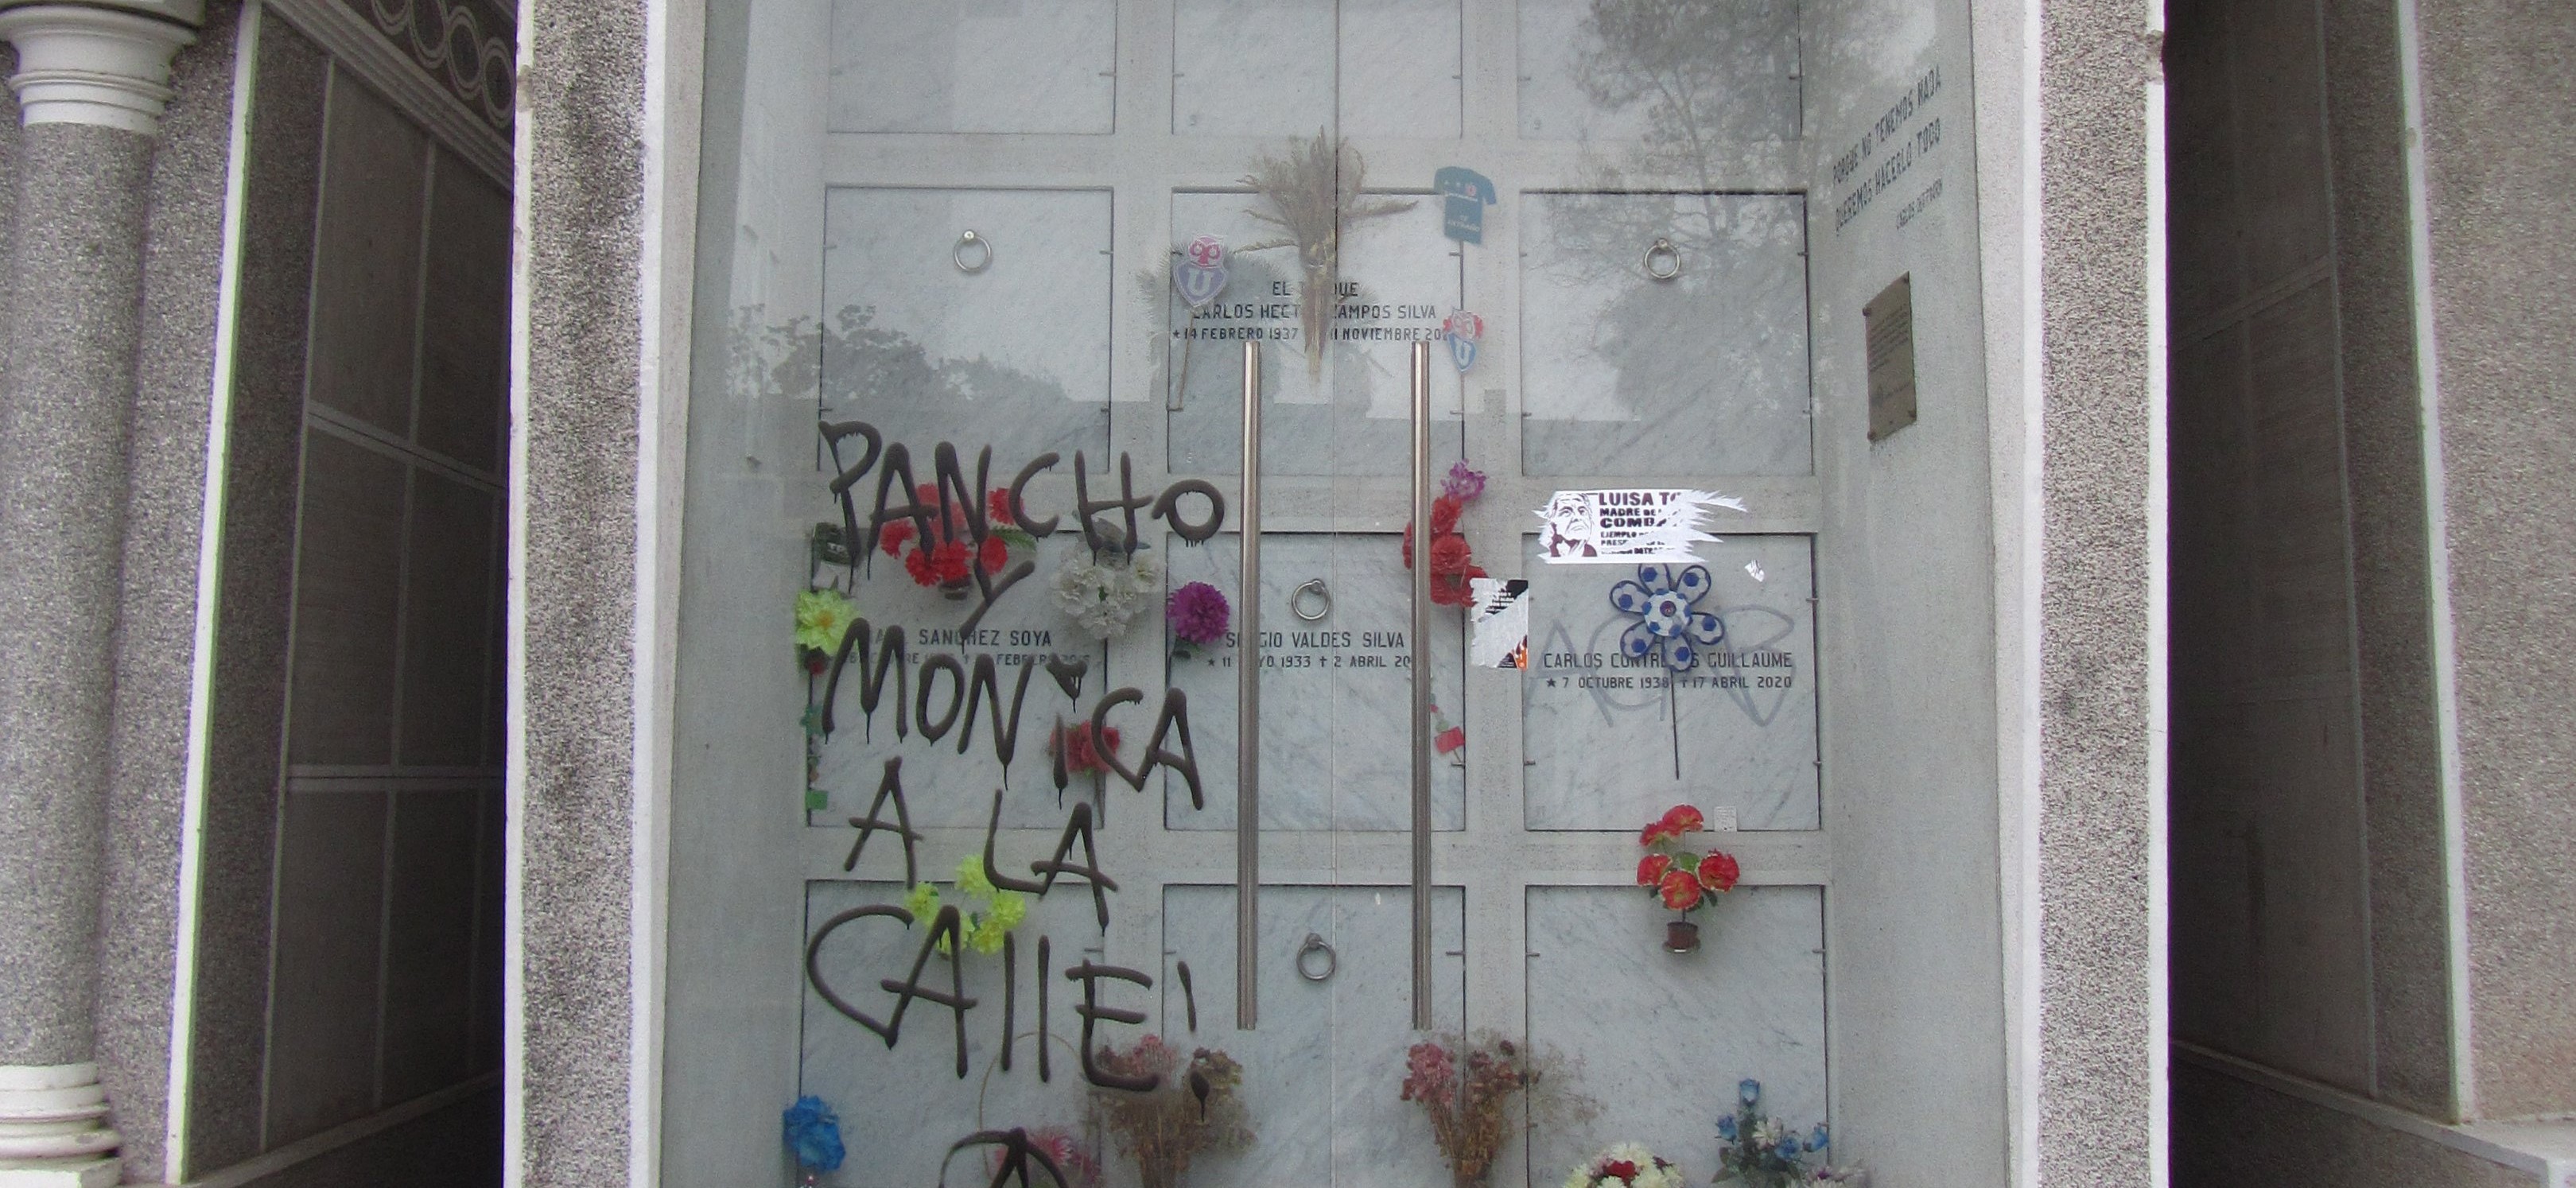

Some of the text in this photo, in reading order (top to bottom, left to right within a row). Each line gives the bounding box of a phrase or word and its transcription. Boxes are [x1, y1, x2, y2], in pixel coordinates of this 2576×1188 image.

[1875, 89, 1914, 145] TENEMOS
[1917, 64, 1941, 108] NADA
[1875, 142, 1913, 196] HACERLO
[1917, 118, 1941, 157] TODO
[1272, 281, 1291, 296] EL
[1261, 304, 1302, 319] HECT
[1397, 305, 1436, 319] SILVA
[1202, 327, 1263, 340] FEBRERO
[1269, 327, 1298, 340] 1937
[1342, 328, 1420, 341] NOVIEMBRE
[818, 420, 1225, 587] PANCHO
[1599, 491, 1654, 506] LUISA
[1599, 507, 1640, 517] MADRE
[960, 560, 1035, 643] Y
[1010, 630, 1052, 646] SOYA
[1292, 631, 1351, 648] VALDES
[1362, 631, 1405, 648] SILVA
[1222, 657, 1231, 668] 11
[1281, 656, 1311, 668] 1933
[1334, 656, 1342, 668] 2
[1350, 656, 1387, 668] ABRIL
[1544, 652, 1603, 669] CARLOS
[1708, 652, 1793, 669] GUILLAUME
[1562, 676, 1793, 689] 7 OCTUBRE 1938 17 ABRIL 2020
[844, 755, 1118, 935] A LA
